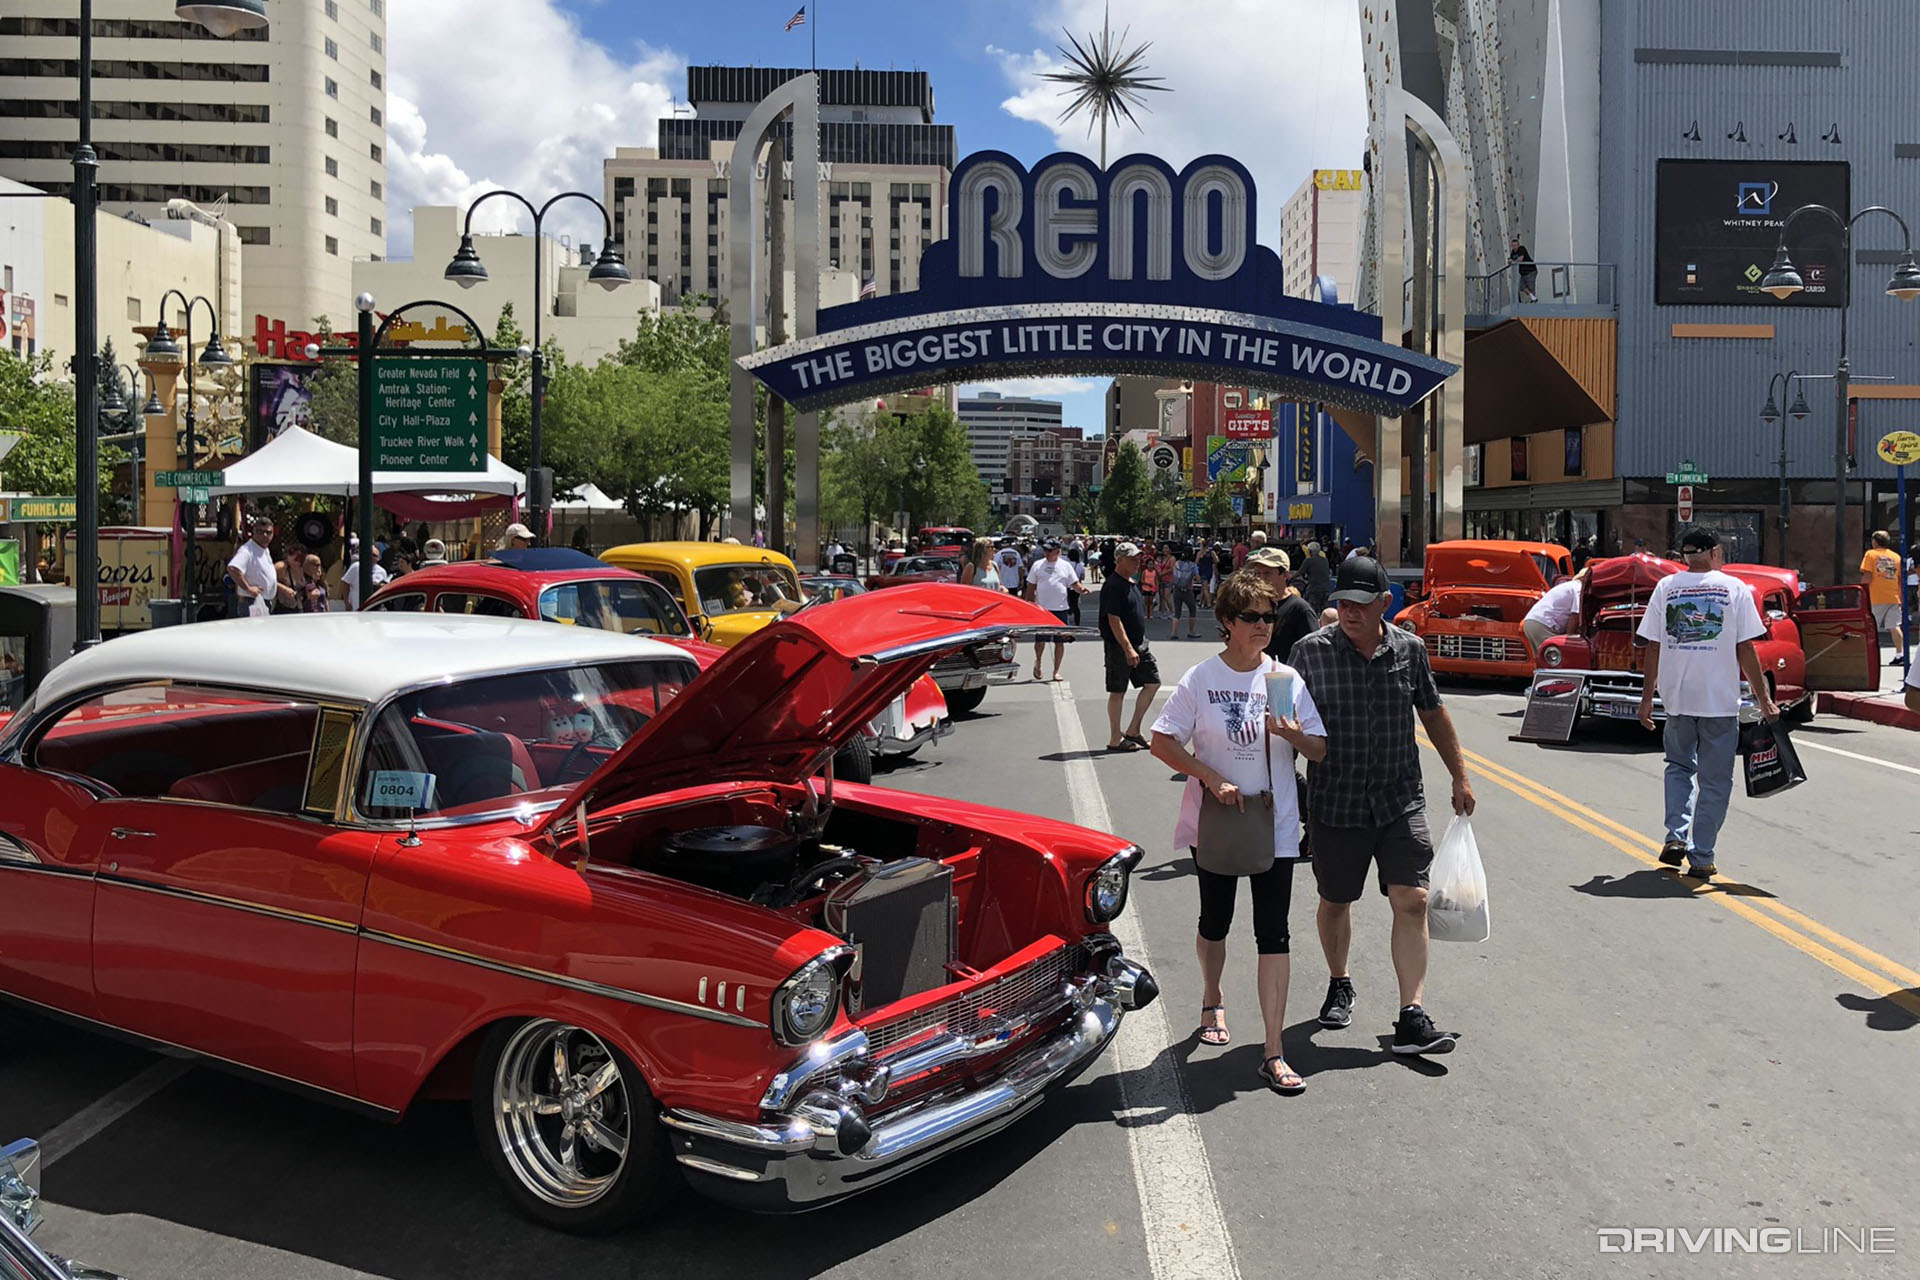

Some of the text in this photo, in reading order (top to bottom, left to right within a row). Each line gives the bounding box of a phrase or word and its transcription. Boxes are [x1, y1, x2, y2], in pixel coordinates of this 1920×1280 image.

[958, 161, 1247, 281] RENO
[791, 324, 1413, 396] THE BIGGEST LITTLE CITY IN THE WORLD
[378, 368, 460, 379] Greater Nevada Field
[379, 384, 411, 395] Amtrak
[385, 396, 456, 411] Heritage Center
[378, 415, 451, 429] City Hall-Plaza
[1228, 419, 1270, 431] GIFTS
[379, 436, 465, 447] Truckee River Walk
[380, 454, 449, 465] Pioneer Center
[167, 472, 173, 485] E
[174, 471, 212, 485] COMMERCIAL
[21, 503, 57, 517] FUNNEL
[97, 556, 154, 584] oors
[1207, 689, 1267, 705] BASS PRO SHO
[380, 785, 415, 796] 0804
